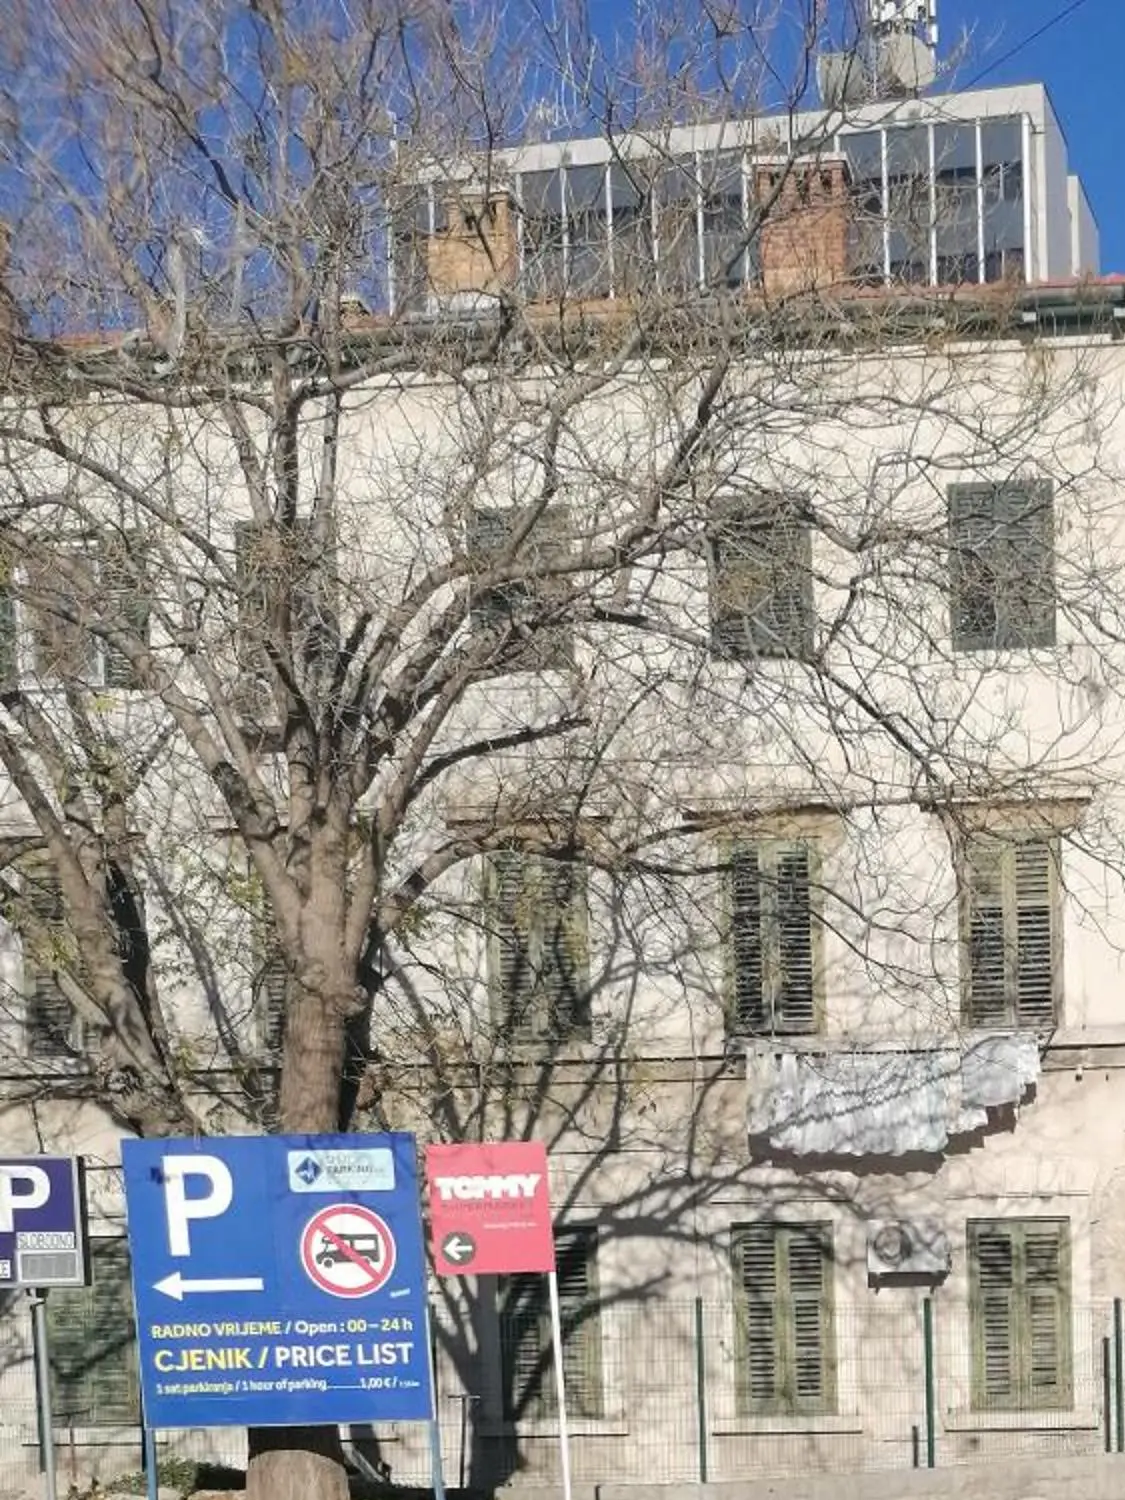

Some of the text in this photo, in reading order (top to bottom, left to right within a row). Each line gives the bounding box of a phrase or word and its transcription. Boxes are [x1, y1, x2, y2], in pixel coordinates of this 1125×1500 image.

[0, 1165, 51, 1232] P
[434, 1173, 542, 1200] TOMMY
[160, 1154, 234, 1257] P
[152, 1322, 211, 1339] RADNO
[213, 1321, 281, 1337] VRIJEME
[285, 1320, 292, 1335] /
[295, 1320, 337, 1336] Open
[154, 1342, 415, 1372] CJENIK / PRICE LIST
